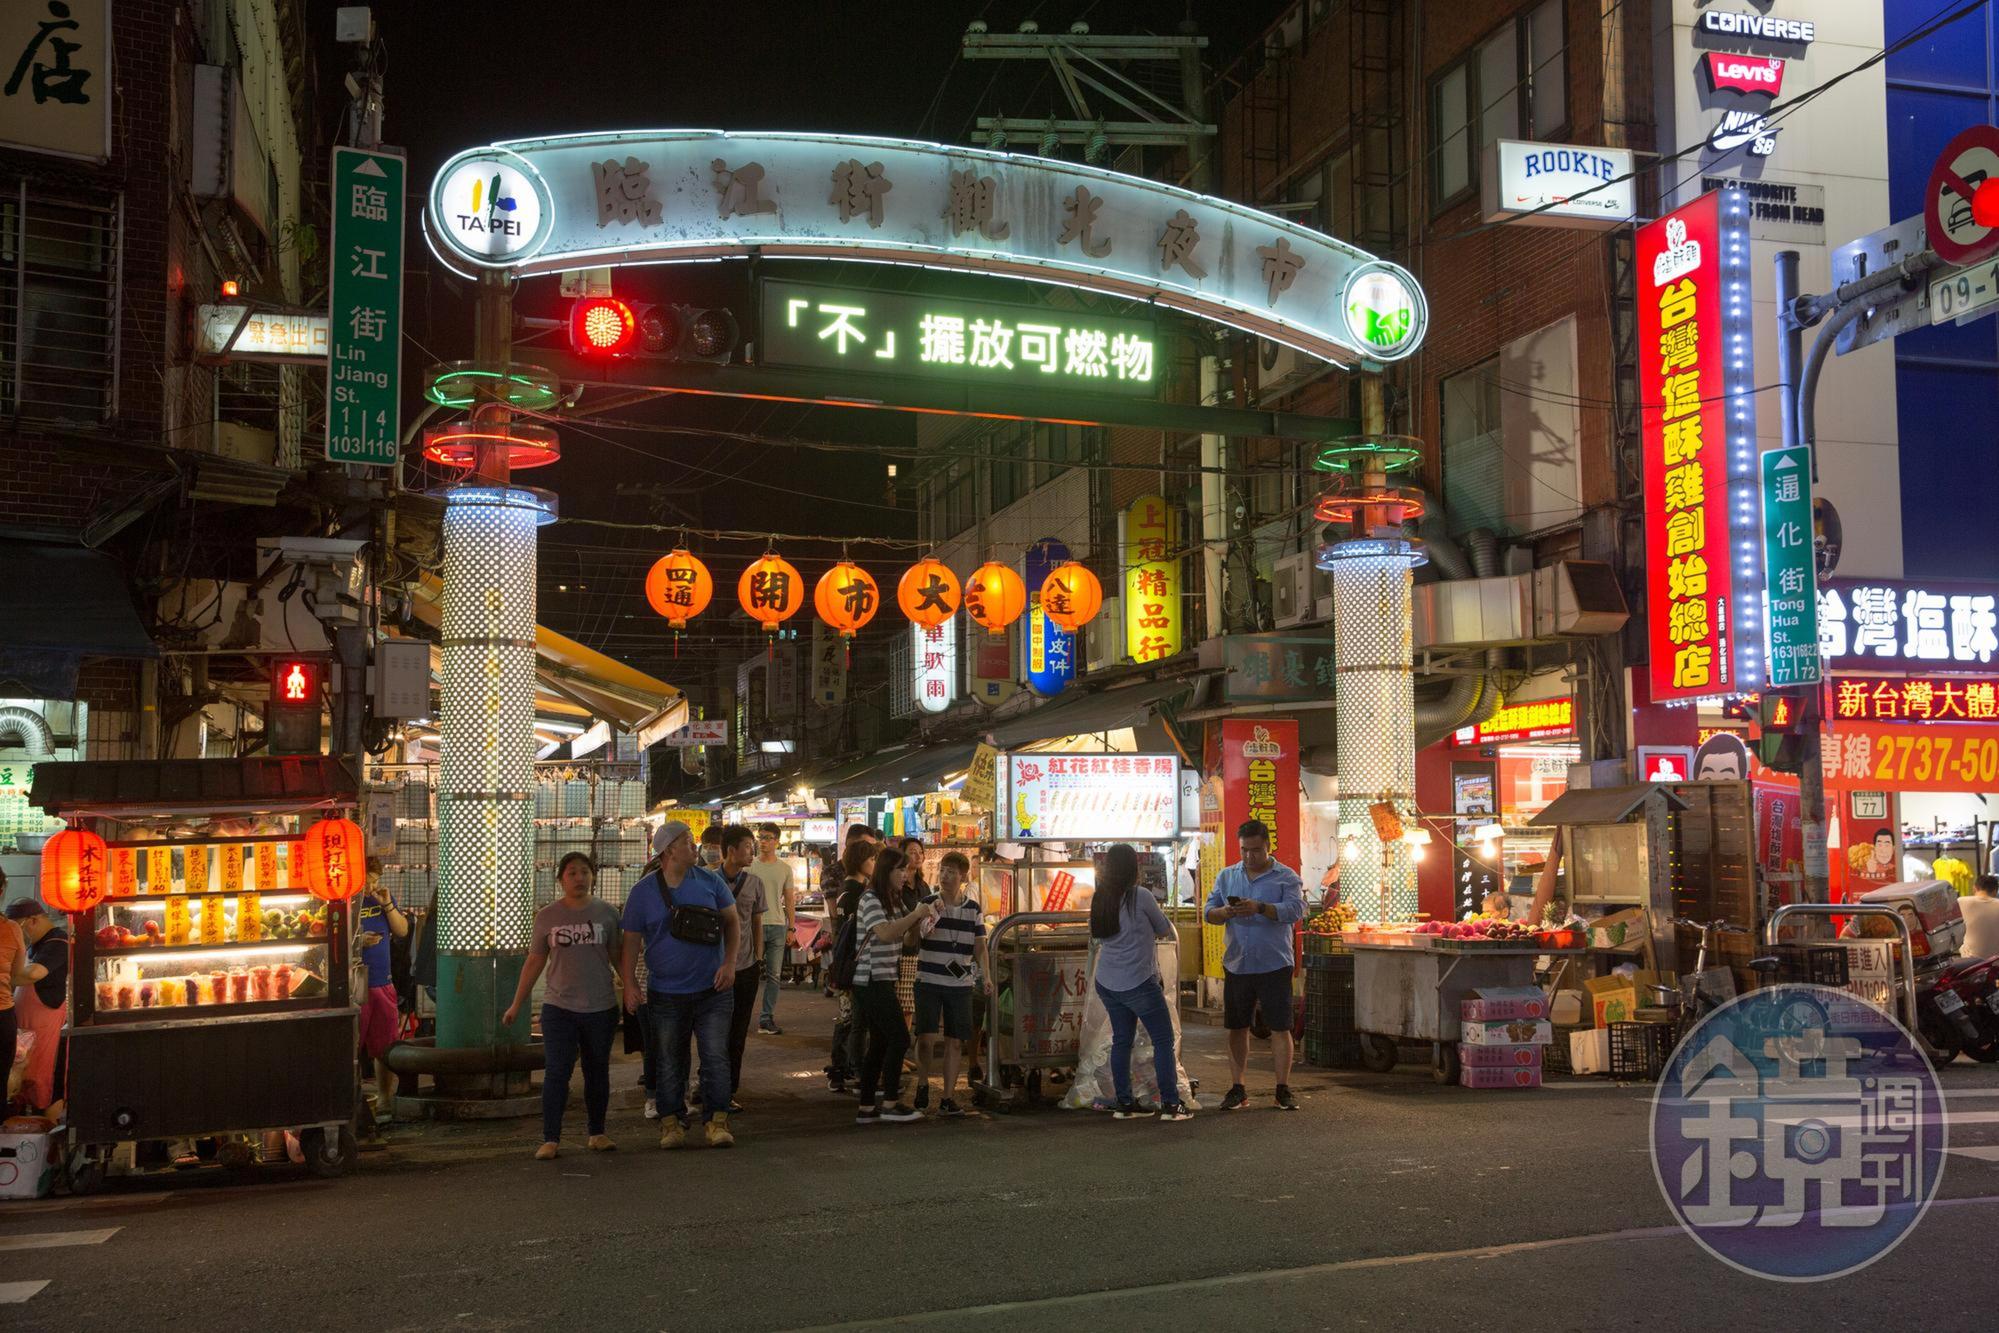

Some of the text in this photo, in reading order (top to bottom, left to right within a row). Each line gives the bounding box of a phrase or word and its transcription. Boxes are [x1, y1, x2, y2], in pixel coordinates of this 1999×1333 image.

[1706, 11, 1814, 41] CONVERSE
[4, 0, 91, 104] 店
[1724, 111, 1768, 135] NIKE
[1752, 138, 1775, 155] SB
[1526, 151, 1614, 183] ROOKIE
[591, 156, 1306, 307] 臨江街觀光夜市
[351, 184, 389, 342] 臨江街
[249, 320, 328, 346] 緊急出口
[336, 343, 366, 362] Lin
[335, 366, 388, 389] Jiang
[335, 385, 361, 404] St.
[342, 406, 349, 423] 1
[376, 409, 387, 427] 4
[332, 436, 361, 455] 103
[367, 438, 396, 458] 116
[1774, 474, 1805, 595] 通化街
[664, 568, 698, 607] 四通
[750, 571, 790, 612] 開
[915, 573, 954, 615] 大
[1137, 503, 1172, 661] 上冠精品行
[837, 578, 877, 621] 市
[1045, 577, 1076, 615] 八達
[1771, 599, 1805, 614] Tong
[1772, 616, 1800, 628] Hua
[1773, 631, 1792, 643] St.
[1773, 645, 1793, 659] 163
[1776, 668, 1791, 682] 77
[1801, 666, 1815, 680] 72
[1837, 680, 1999, 719] 新台灣大體
[1874, 735, 1999, 783] 2737-50
[1863, 802, 1877, 814] 77
